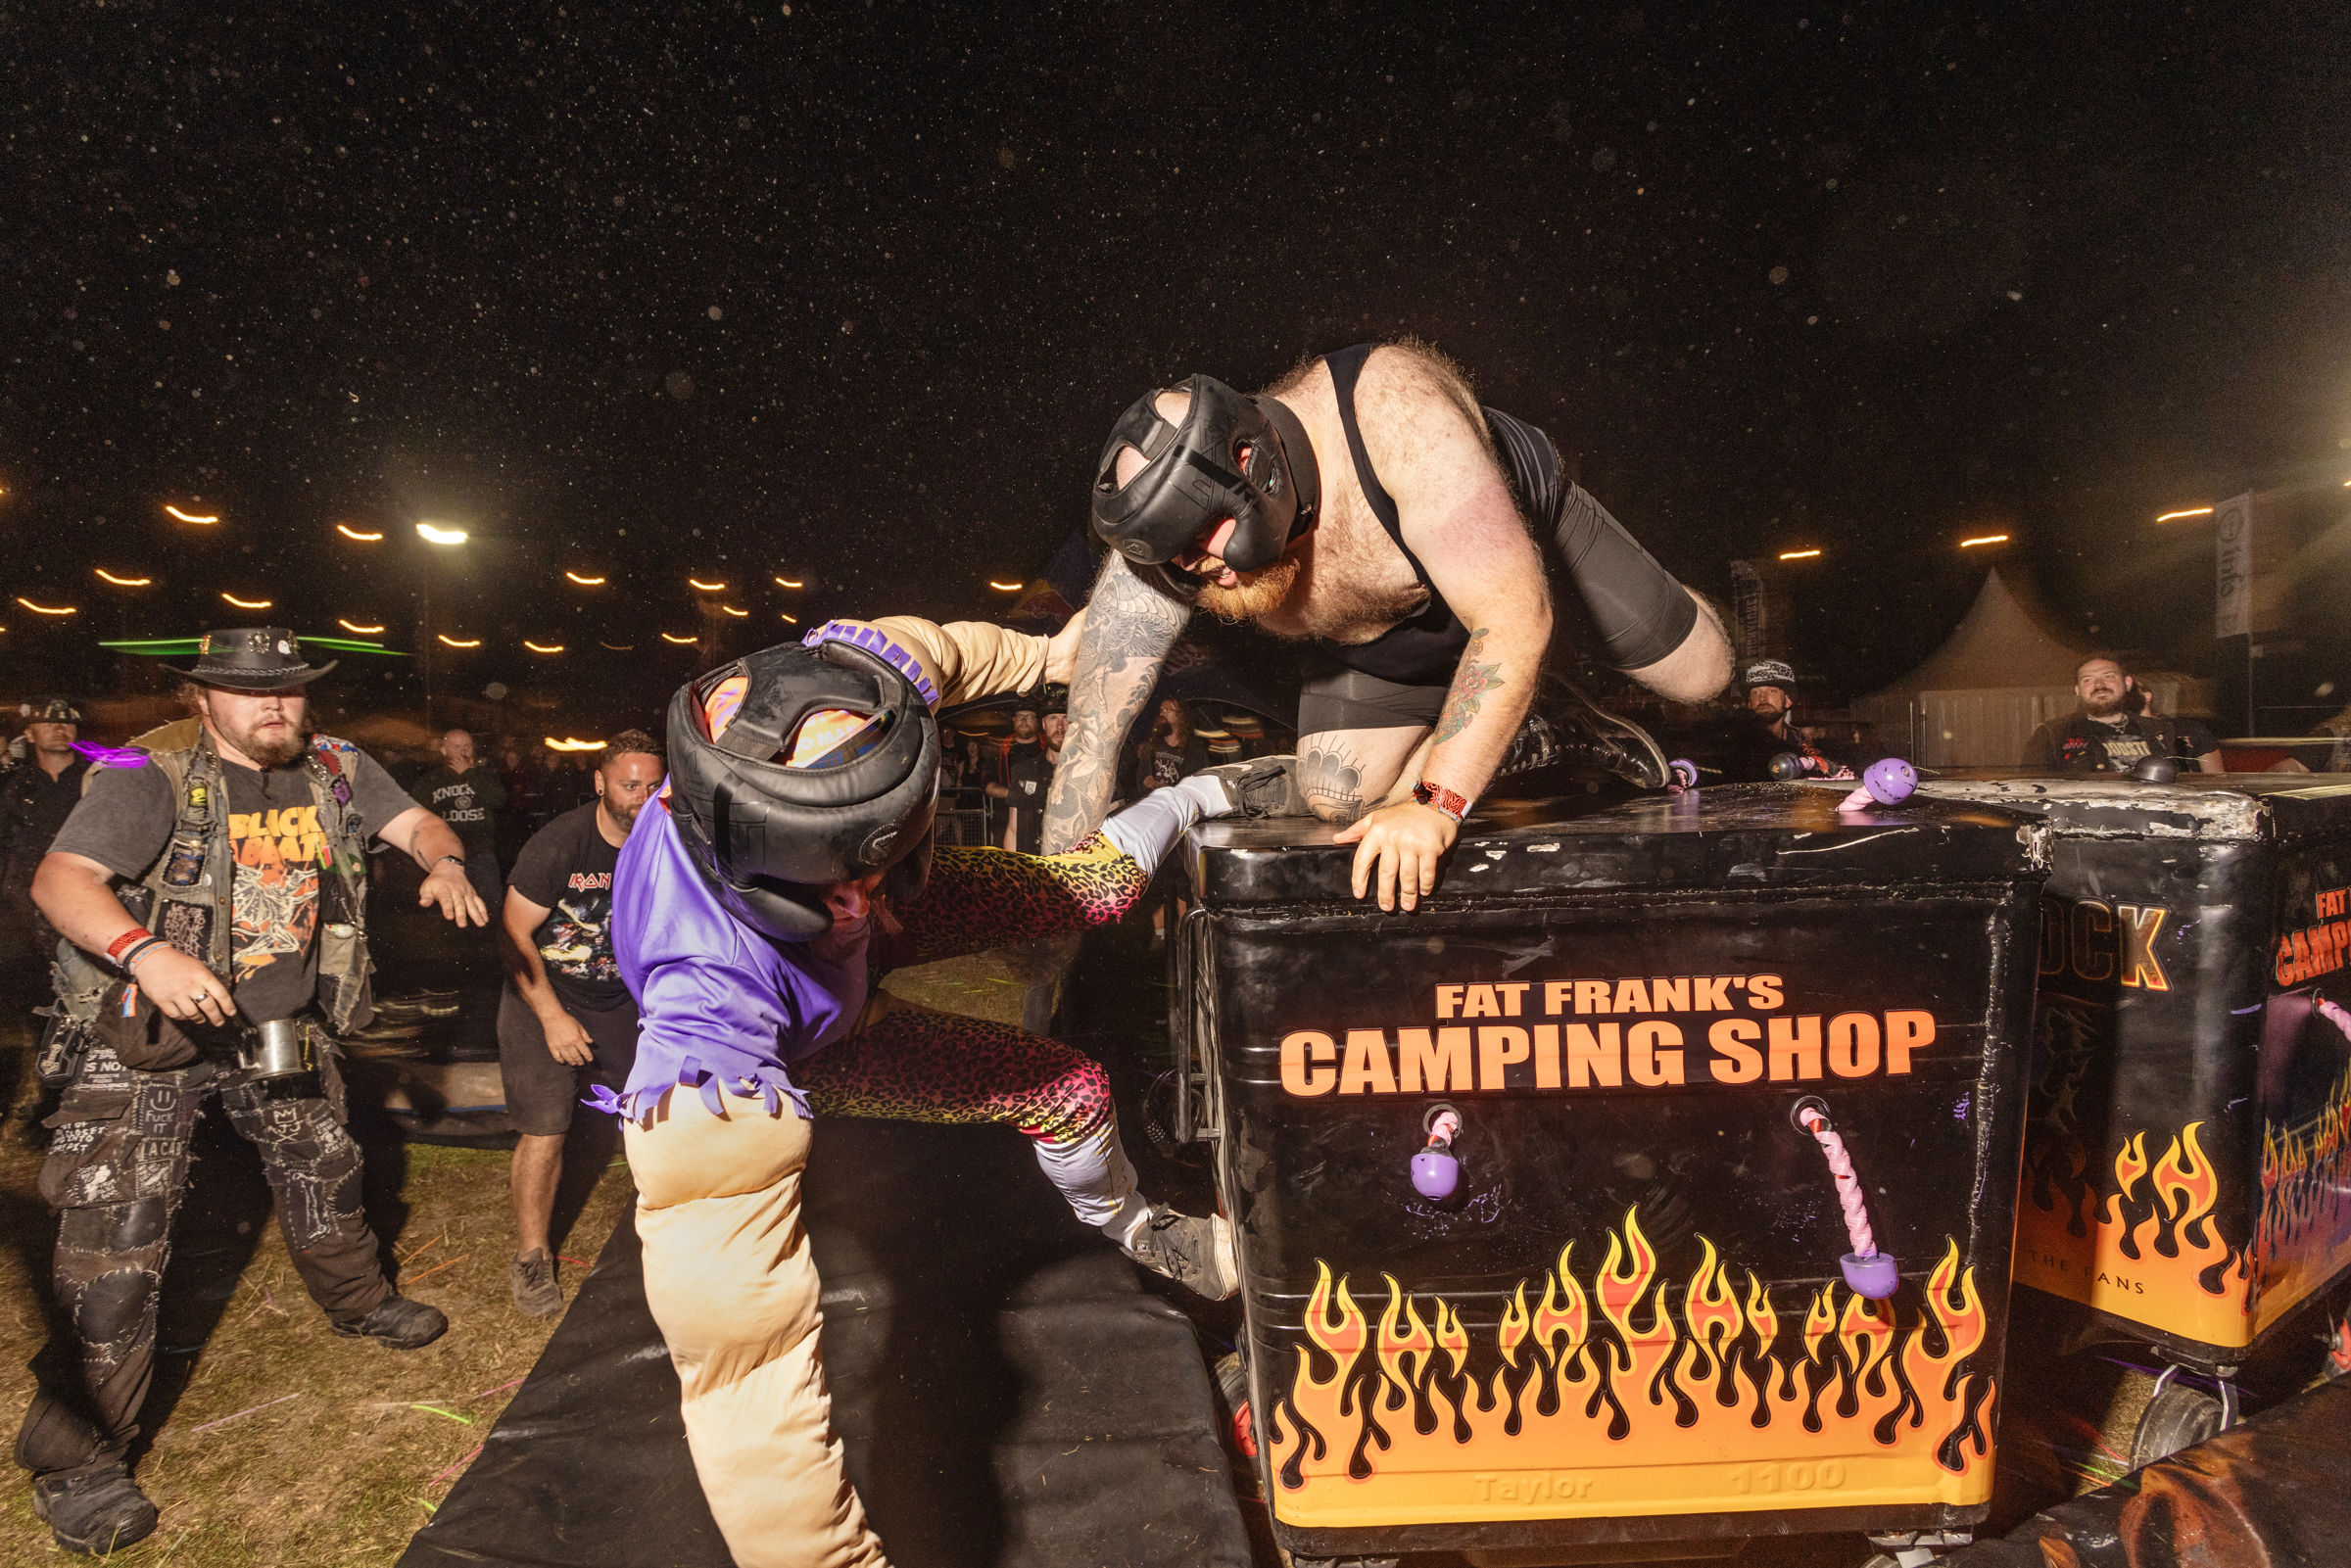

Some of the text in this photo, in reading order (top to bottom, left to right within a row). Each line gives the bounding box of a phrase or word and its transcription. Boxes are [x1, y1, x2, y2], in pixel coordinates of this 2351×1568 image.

[432, 783, 475, 804] KNOCK
[228, 805, 323, 839] BLACK
[442, 807, 486, 822] LOOSE
[568, 872, 612, 893] IRON
[2316, 888, 2346, 920] FAT
[1436, 974, 1785, 1019] FAT FRANK'S
[1278, 1009, 1937, 1097] CAMPING SHOP
[154, 1122, 168, 1134] IT
[2083, 1265, 2144, 1295] FANS
[1473, 1461, 1847, 1504] Taylor 1100
